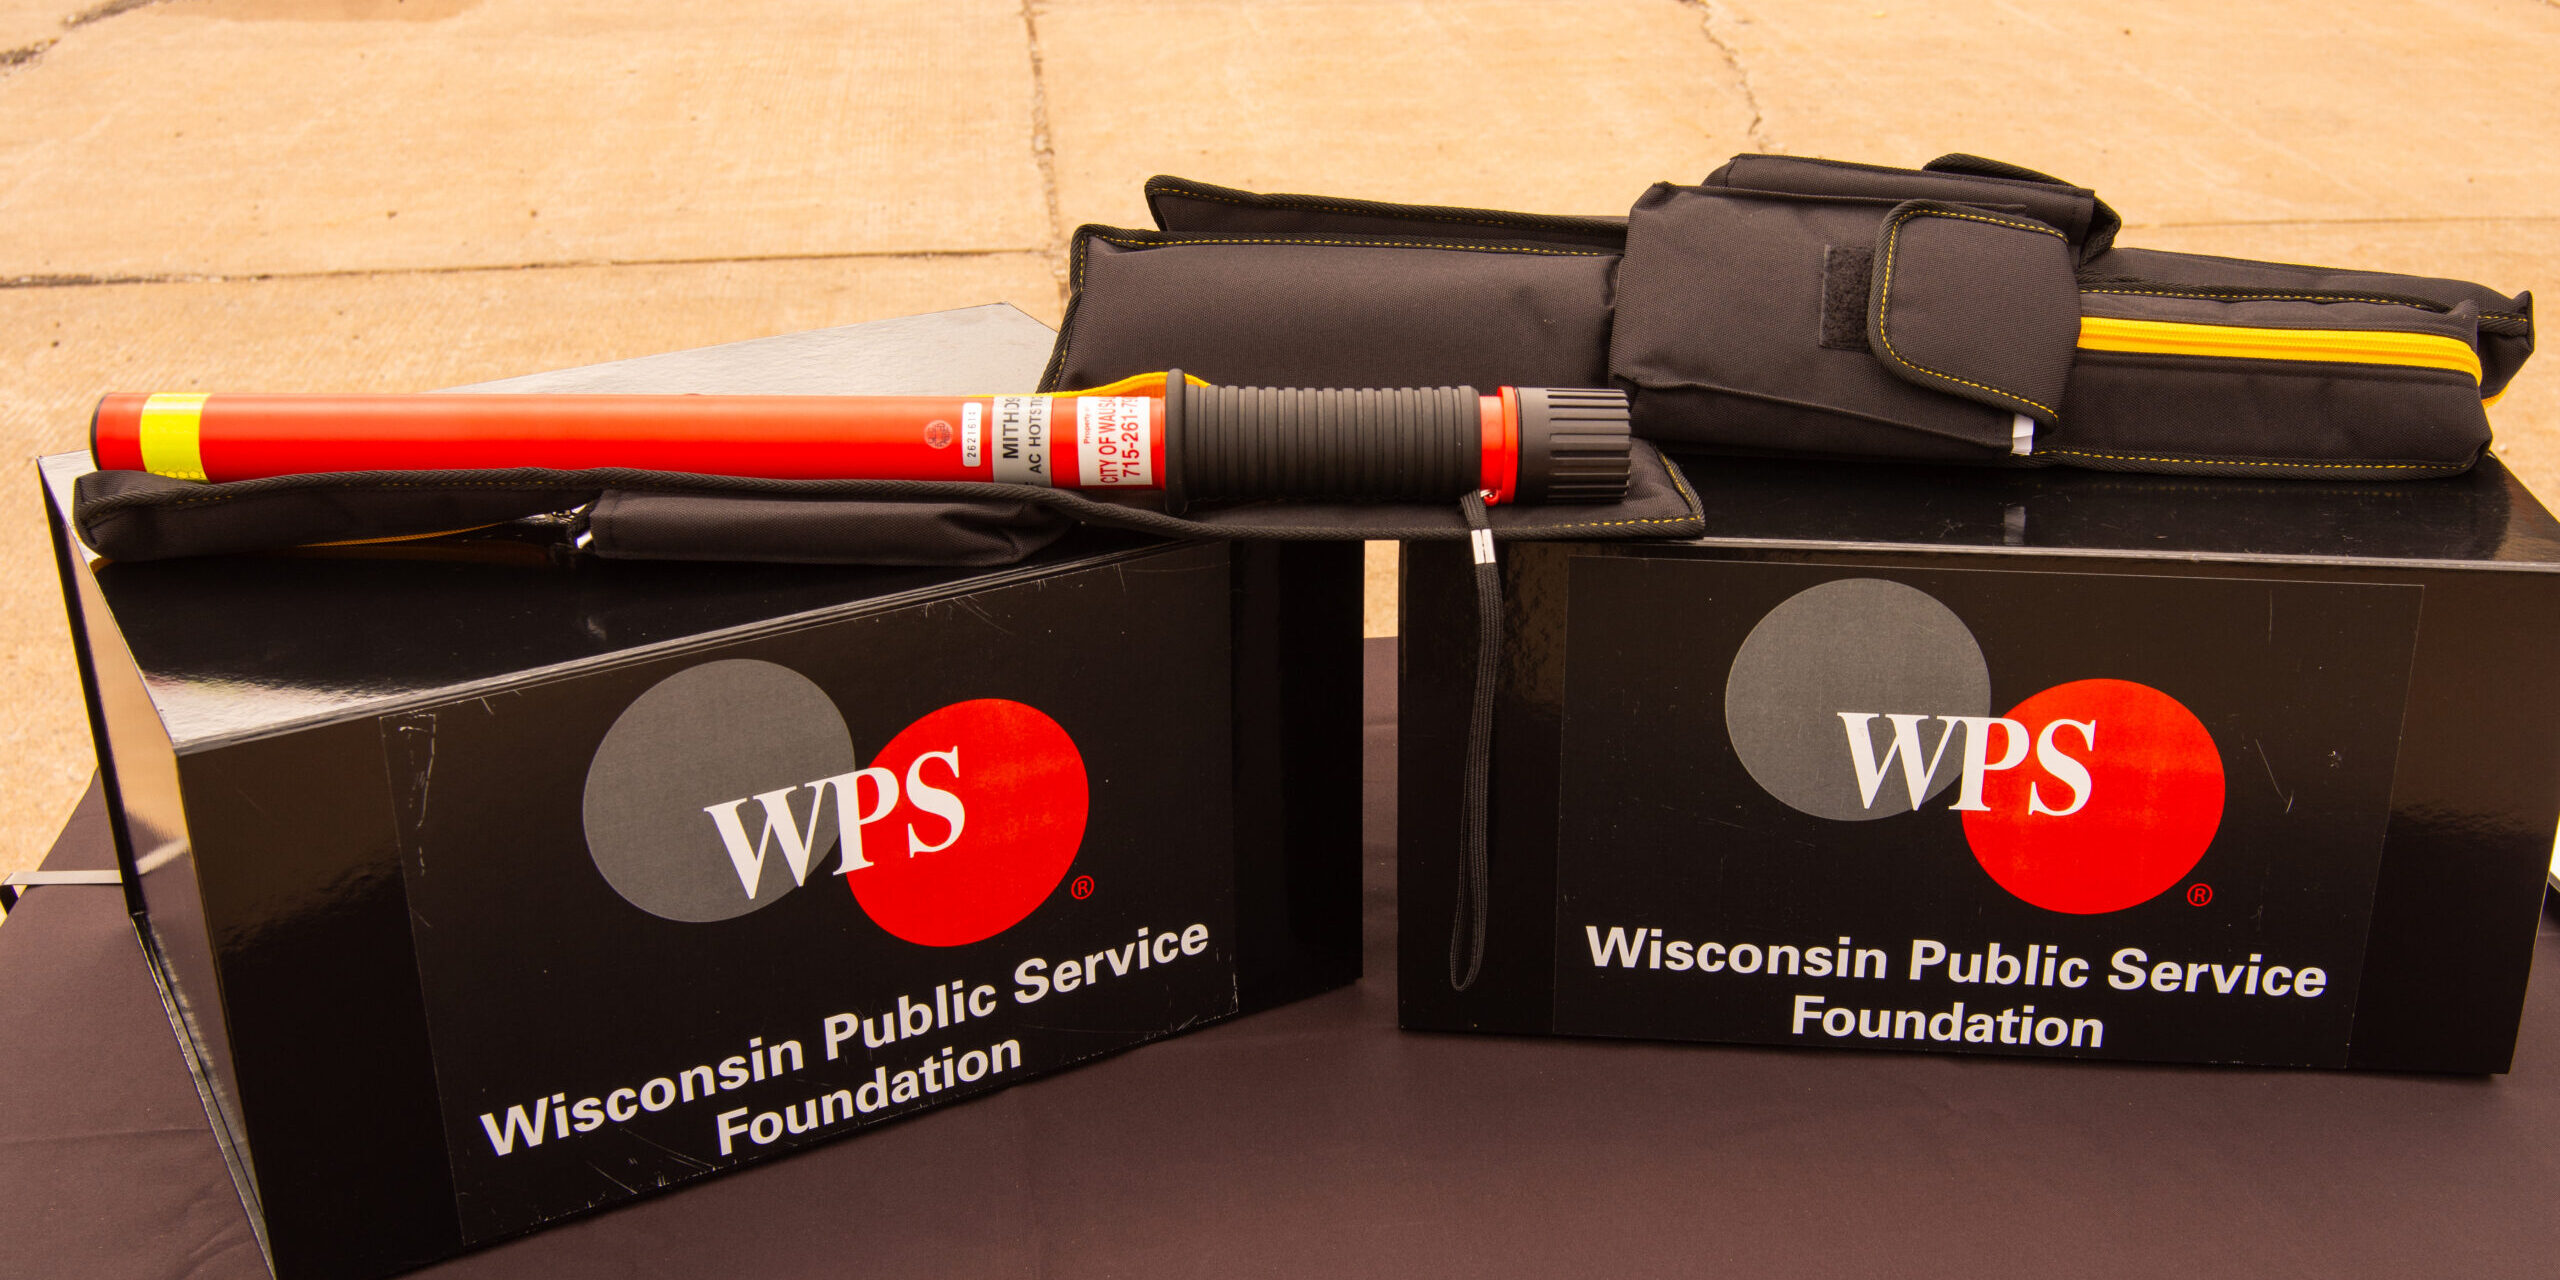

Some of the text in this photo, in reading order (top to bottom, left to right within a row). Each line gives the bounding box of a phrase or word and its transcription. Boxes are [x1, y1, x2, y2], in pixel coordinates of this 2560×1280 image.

[1028, 453, 1042, 474] AC
[1098, 436, 1117, 455] OF
[1099, 459, 1119, 484] CITY
[1837, 711, 2096, 817] WPS
[704, 745, 965, 899] WPS
[1586, 926, 2327, 998] Wisconsin Public Service
[481, 922, 1209, 1156] Wisconsin Public Service
[1793, 995, 2104, 1048] Foundation
[717, 1039, 1022, 1156] Foundation
